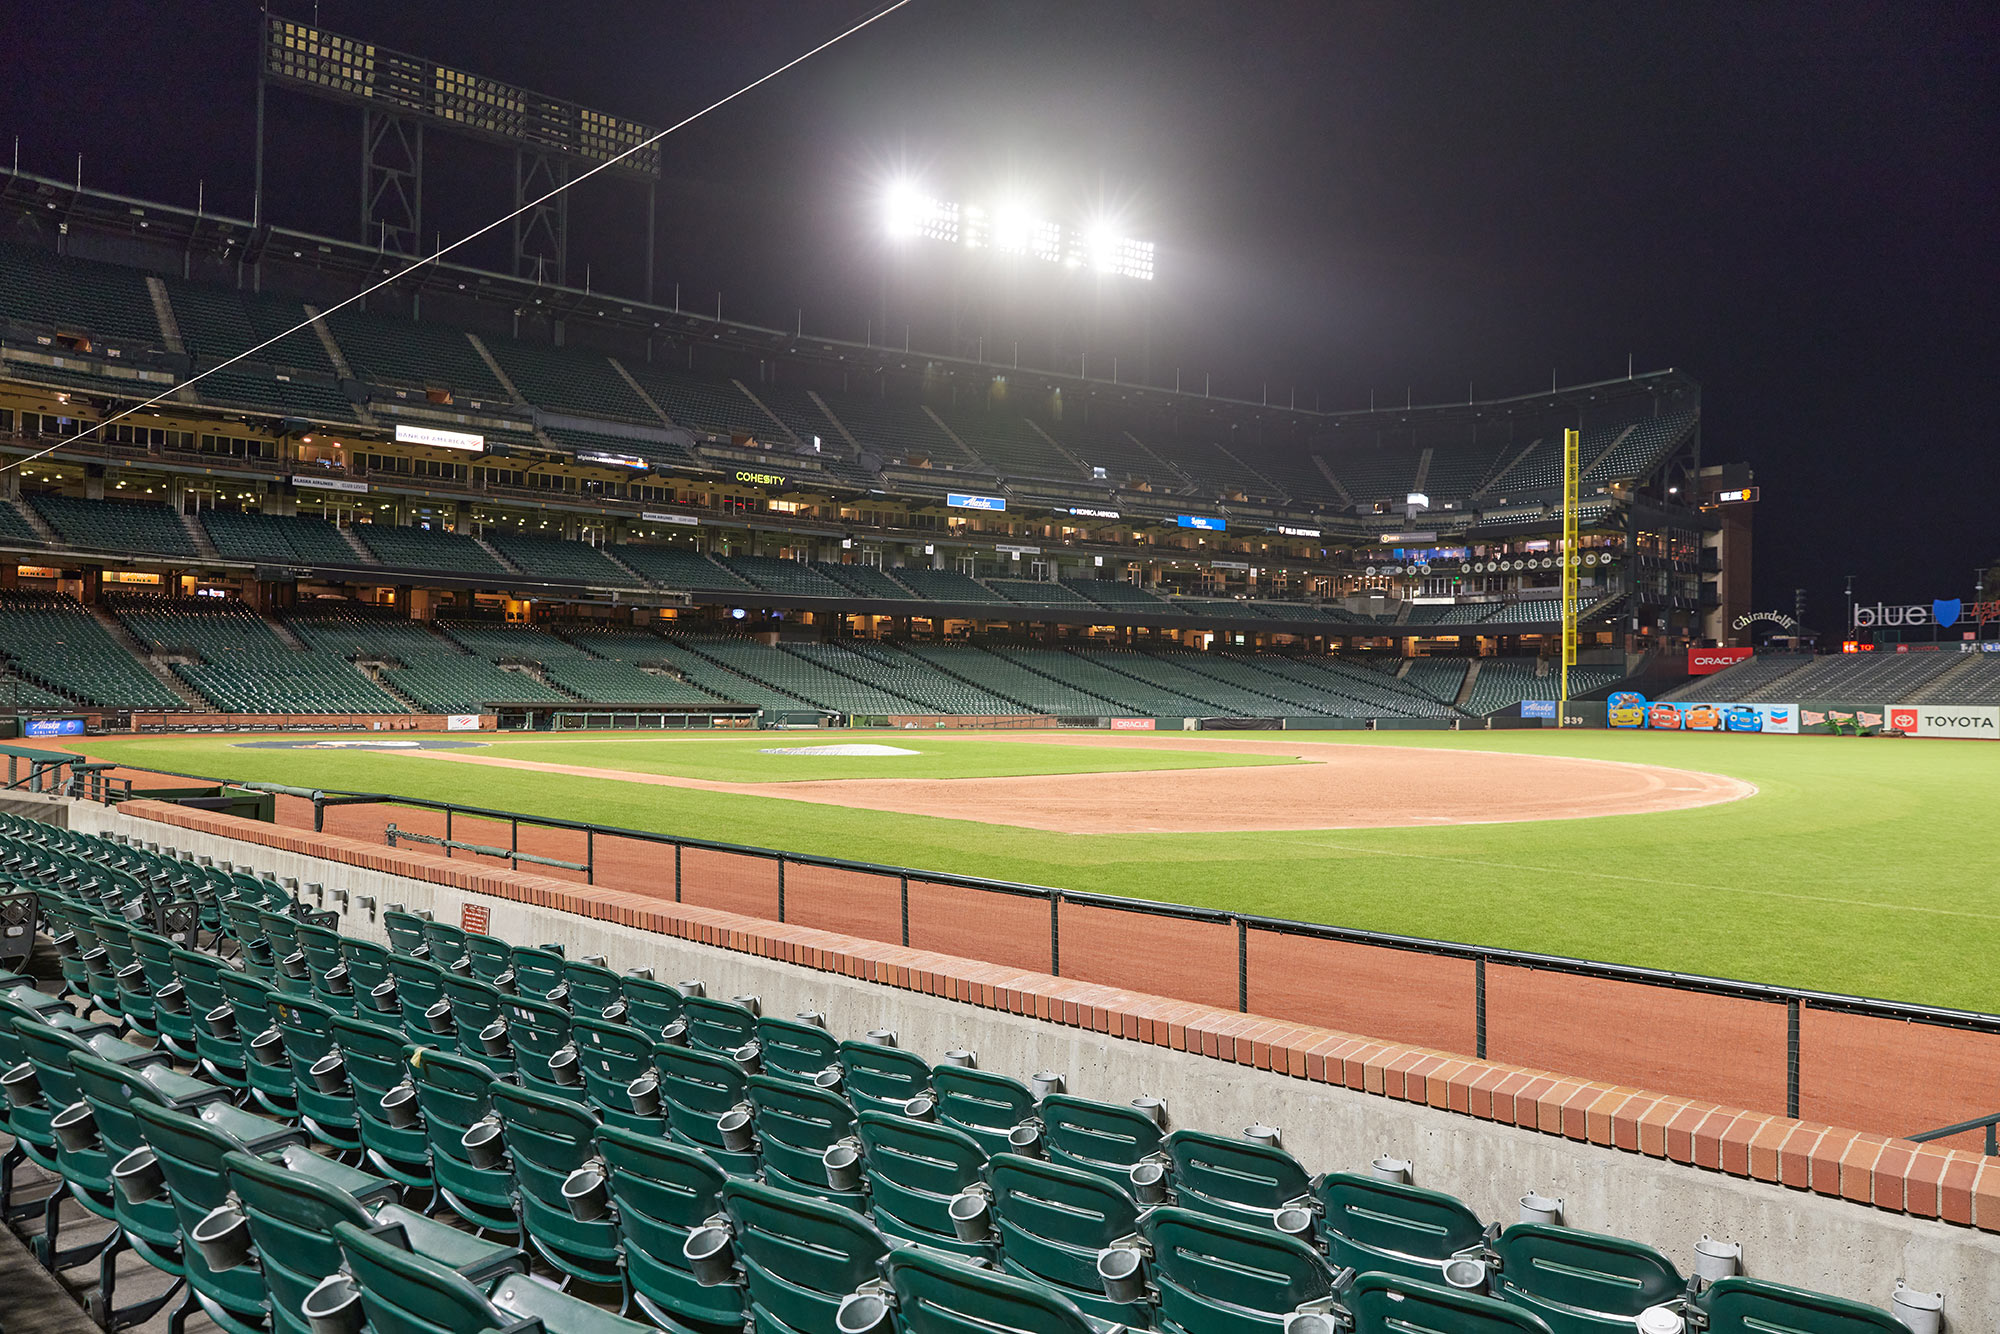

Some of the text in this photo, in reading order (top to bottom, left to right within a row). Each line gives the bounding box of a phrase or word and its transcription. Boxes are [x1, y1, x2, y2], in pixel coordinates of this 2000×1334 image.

[432, 436, 465, 445] AMERICA
[736, 471, 786, 486] COHESITY
[1076, 508, 1120, 519] KONICA MINOLTA
[1854, 602, 1927, 627] blue
[1732, 610, 1793, 631] Ghirardelli
[1524, 702, 1553, 712] Alaska
[32, 720, 60, 729] Alaska
[1117, 720, 1149, 728] ORACLE
[1564, 716, 1583, 725] 339
[1925, 716, 1994, 728] TOYOTA
